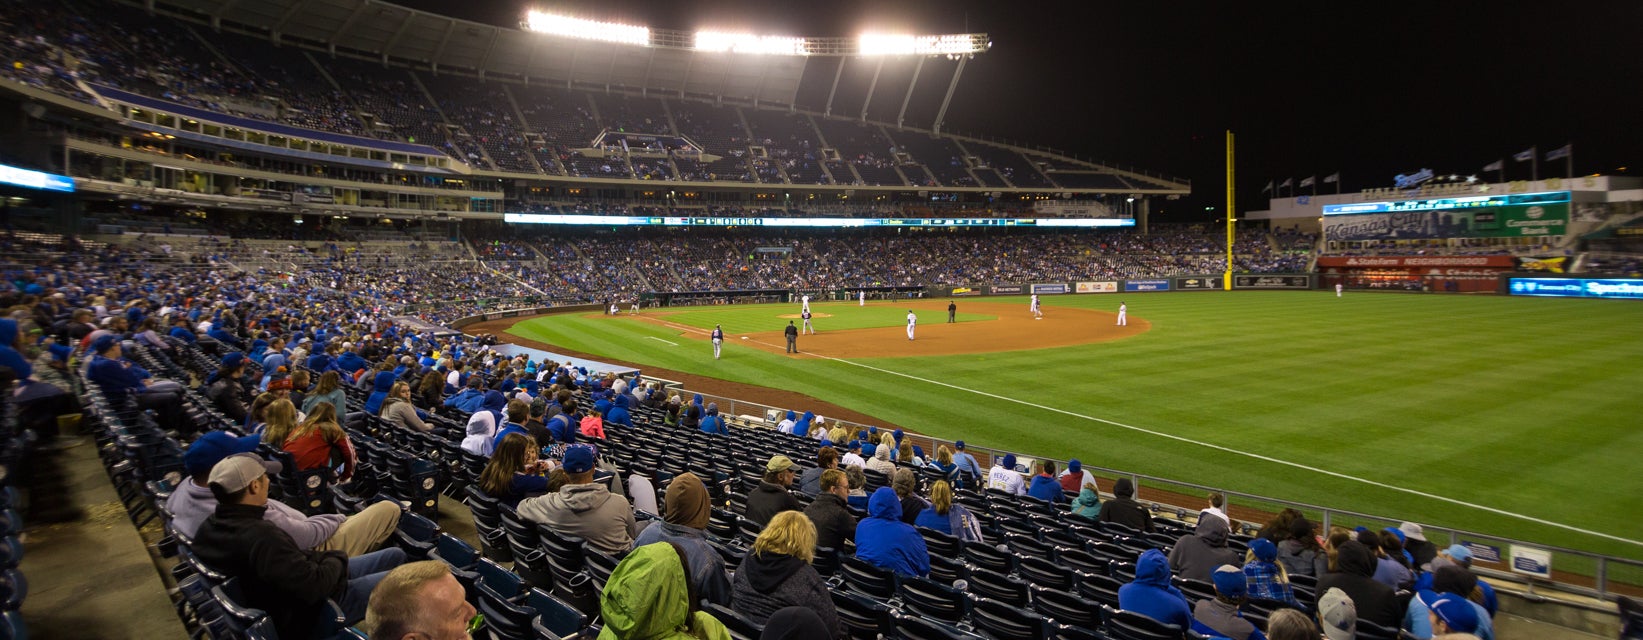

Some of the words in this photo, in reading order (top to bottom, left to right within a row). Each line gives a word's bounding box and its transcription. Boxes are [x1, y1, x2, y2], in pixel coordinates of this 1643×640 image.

[1325, 218, 1387, 241] Kansas
[1388, 210, 1426, 229] City
[1506, 219, 1563, 227] Commerce
[1521, 227, 1548, 235] Bank
[1403, 257, 1486, 266] NEIGHBORHOOD
[994, 472, 1010, 482] PEREZ
